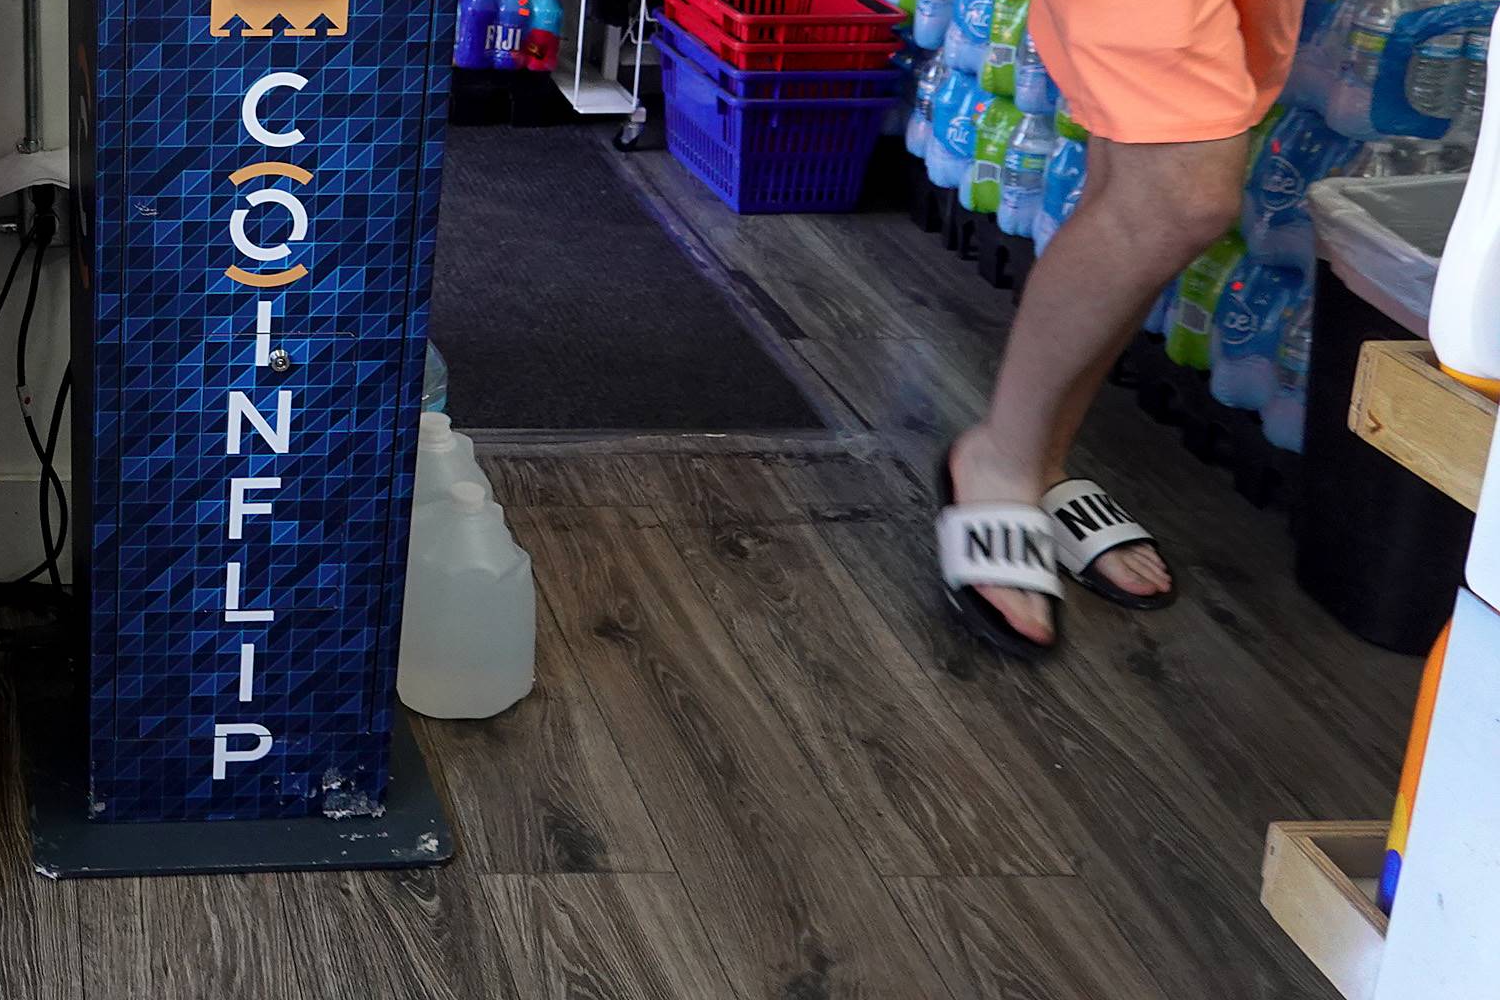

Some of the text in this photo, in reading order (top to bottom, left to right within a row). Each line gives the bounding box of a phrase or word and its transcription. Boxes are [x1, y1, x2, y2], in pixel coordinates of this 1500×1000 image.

[485, 24, 522, 53] FIJI
[211, 72, 309, 781] COINFLIP
[1054, 493, 1138, 542] NIK
[962, 521, 1052, 572] NIK
